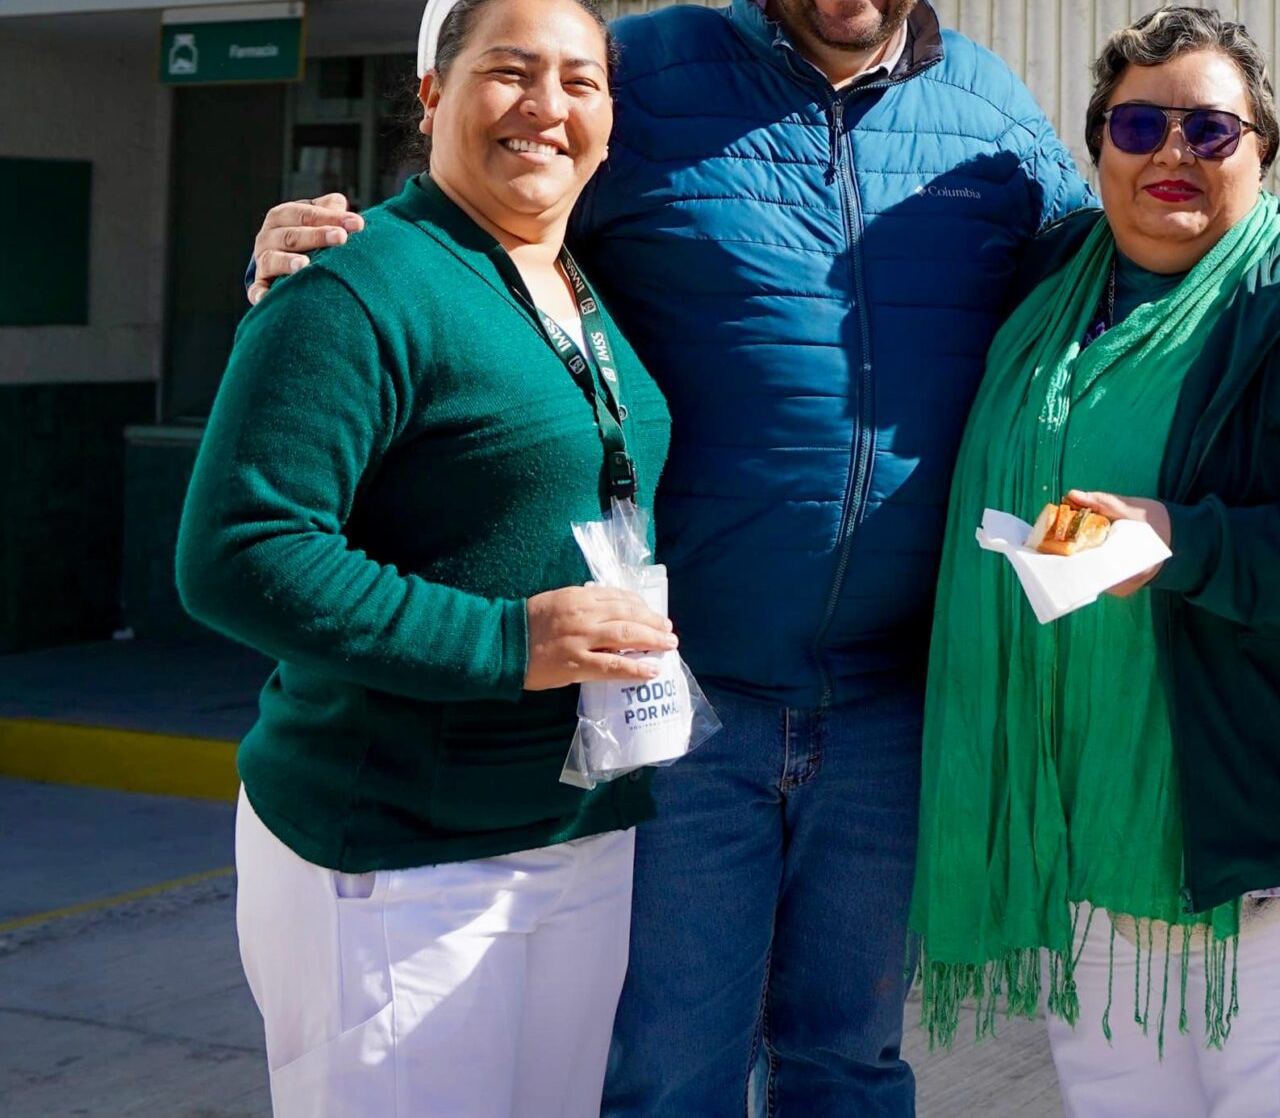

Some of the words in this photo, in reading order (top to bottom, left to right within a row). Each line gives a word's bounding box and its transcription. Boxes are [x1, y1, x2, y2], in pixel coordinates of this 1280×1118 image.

[229, 43, 279, 58] Farmacia
[927, 185, 981, 199] Columbia
[565, 257, 585, 293] IMSS
[541, 317, 572, 353] IMSS
[591, 331, 610, 361] IMSS
[624, 706, 658, 724] POR
